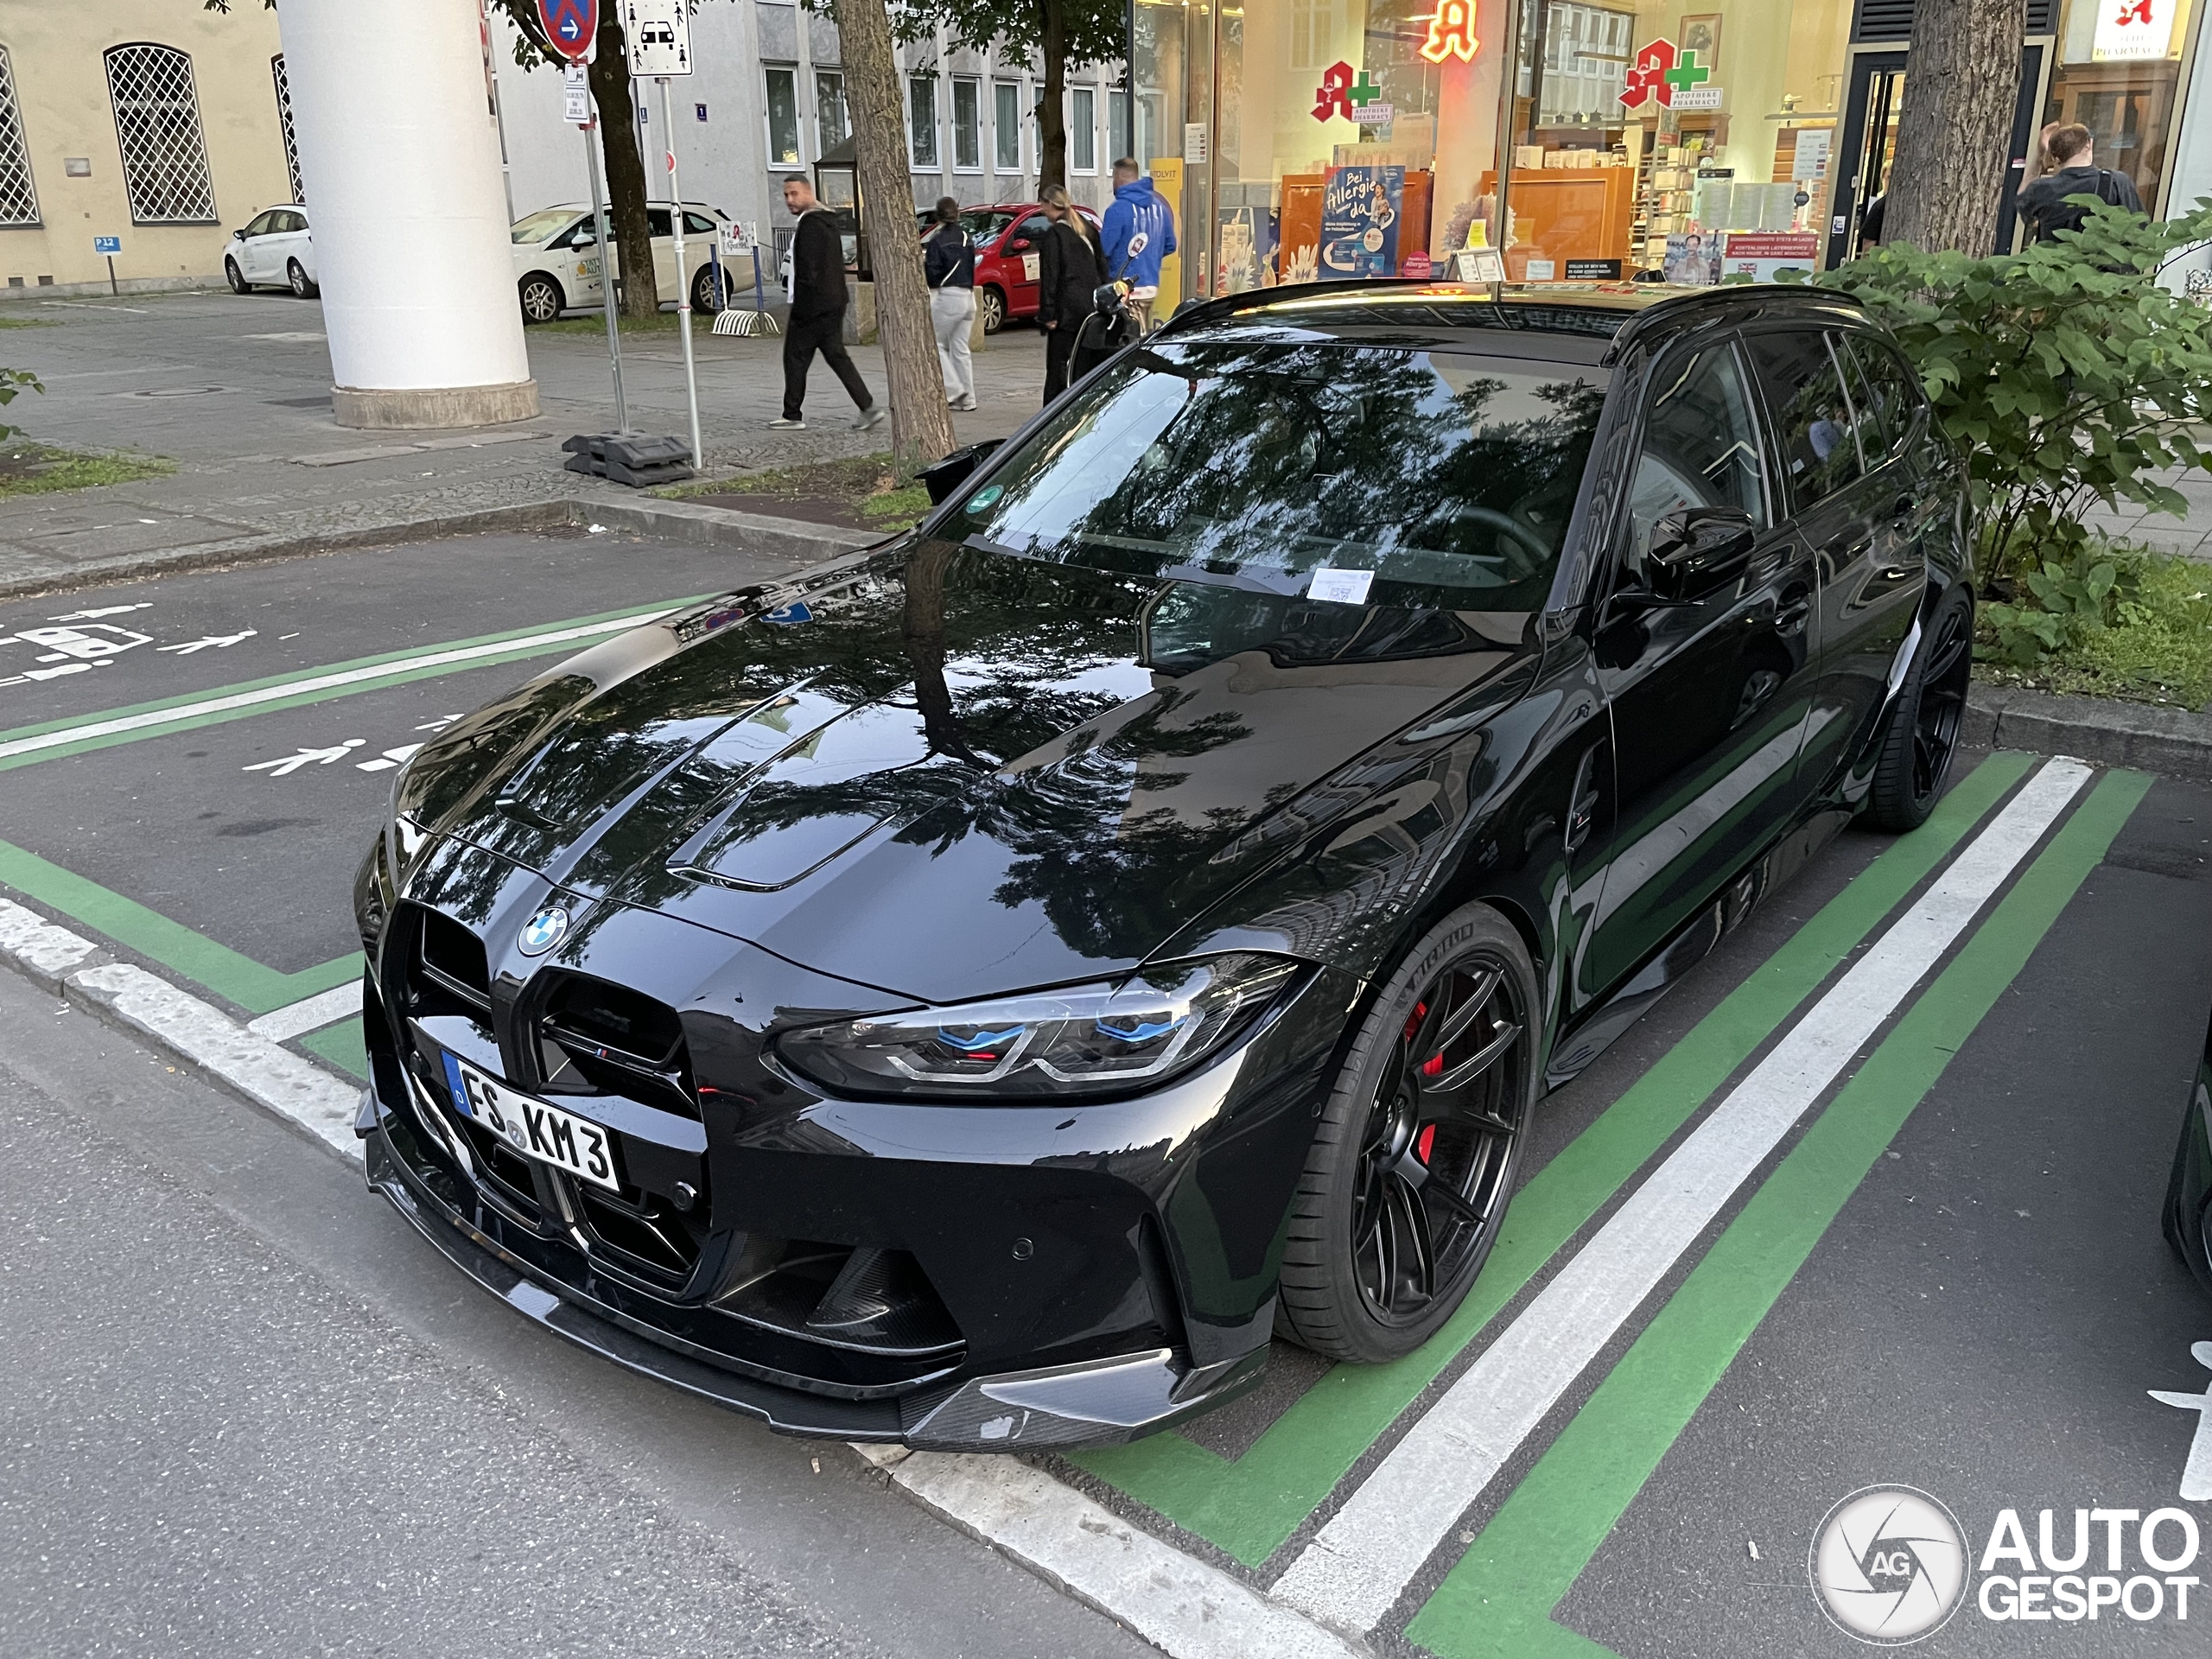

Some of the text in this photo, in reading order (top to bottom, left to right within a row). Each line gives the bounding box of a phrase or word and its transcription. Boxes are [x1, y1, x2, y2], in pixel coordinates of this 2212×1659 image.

[1346, 171, 1363, 186] Bei
[1326, 178, 1376, 210] Allergie
[1350, 201, 1370, 219] da
[95, 238, 114, 246] P 12
[1412, 922, 1474, 987] MICHELIN
[455, 1090, 465, 1105] D
[461, 1070, 506, 1133] FS
